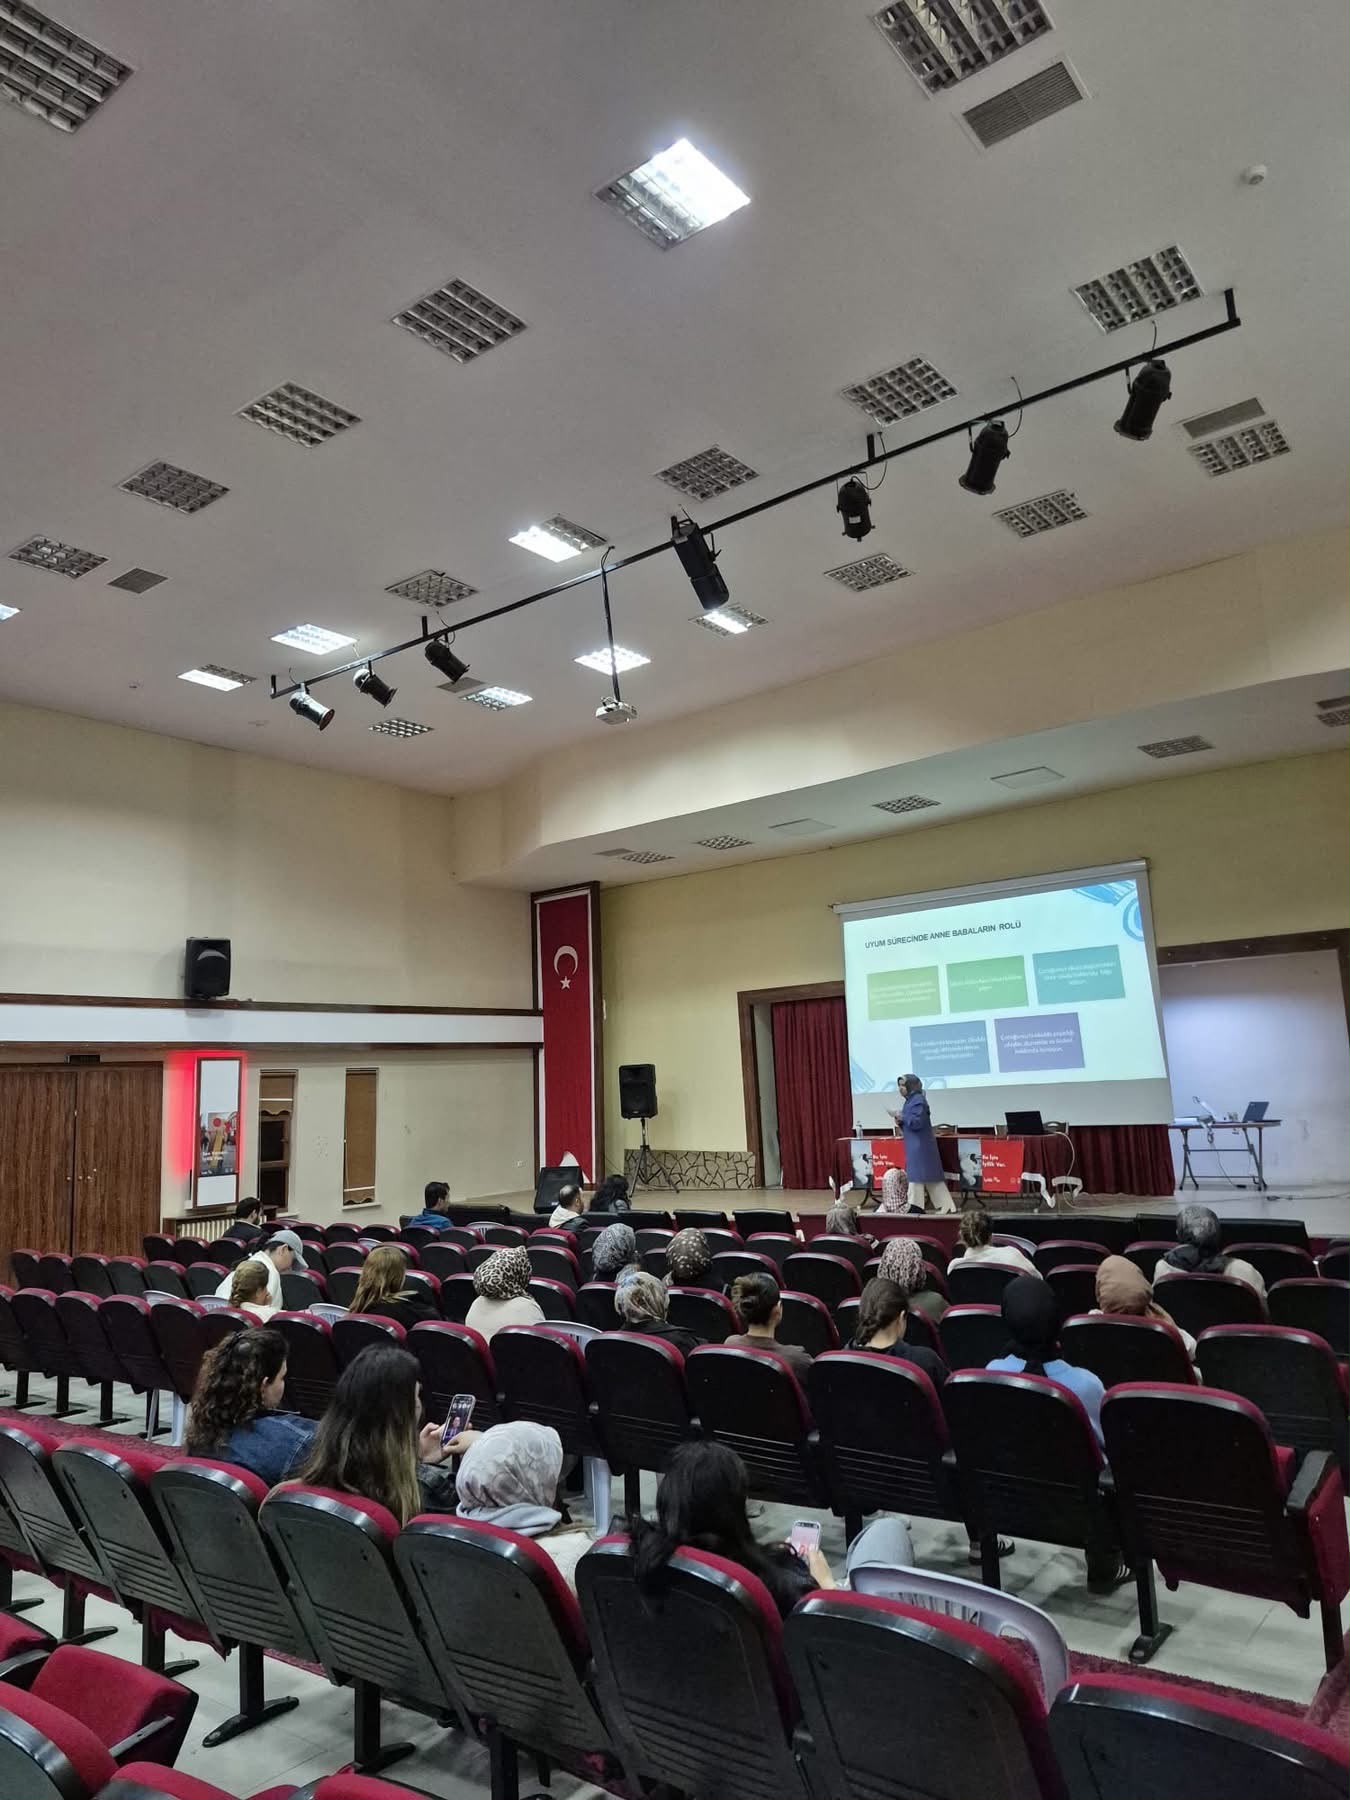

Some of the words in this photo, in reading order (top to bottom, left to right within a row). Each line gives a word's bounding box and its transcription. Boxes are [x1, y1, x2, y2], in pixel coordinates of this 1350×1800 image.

[864, 939, 886, 949] UYUM
[930, 930, 951, 940] ANNE
[952, 924, 996, 937] BABALARIN
